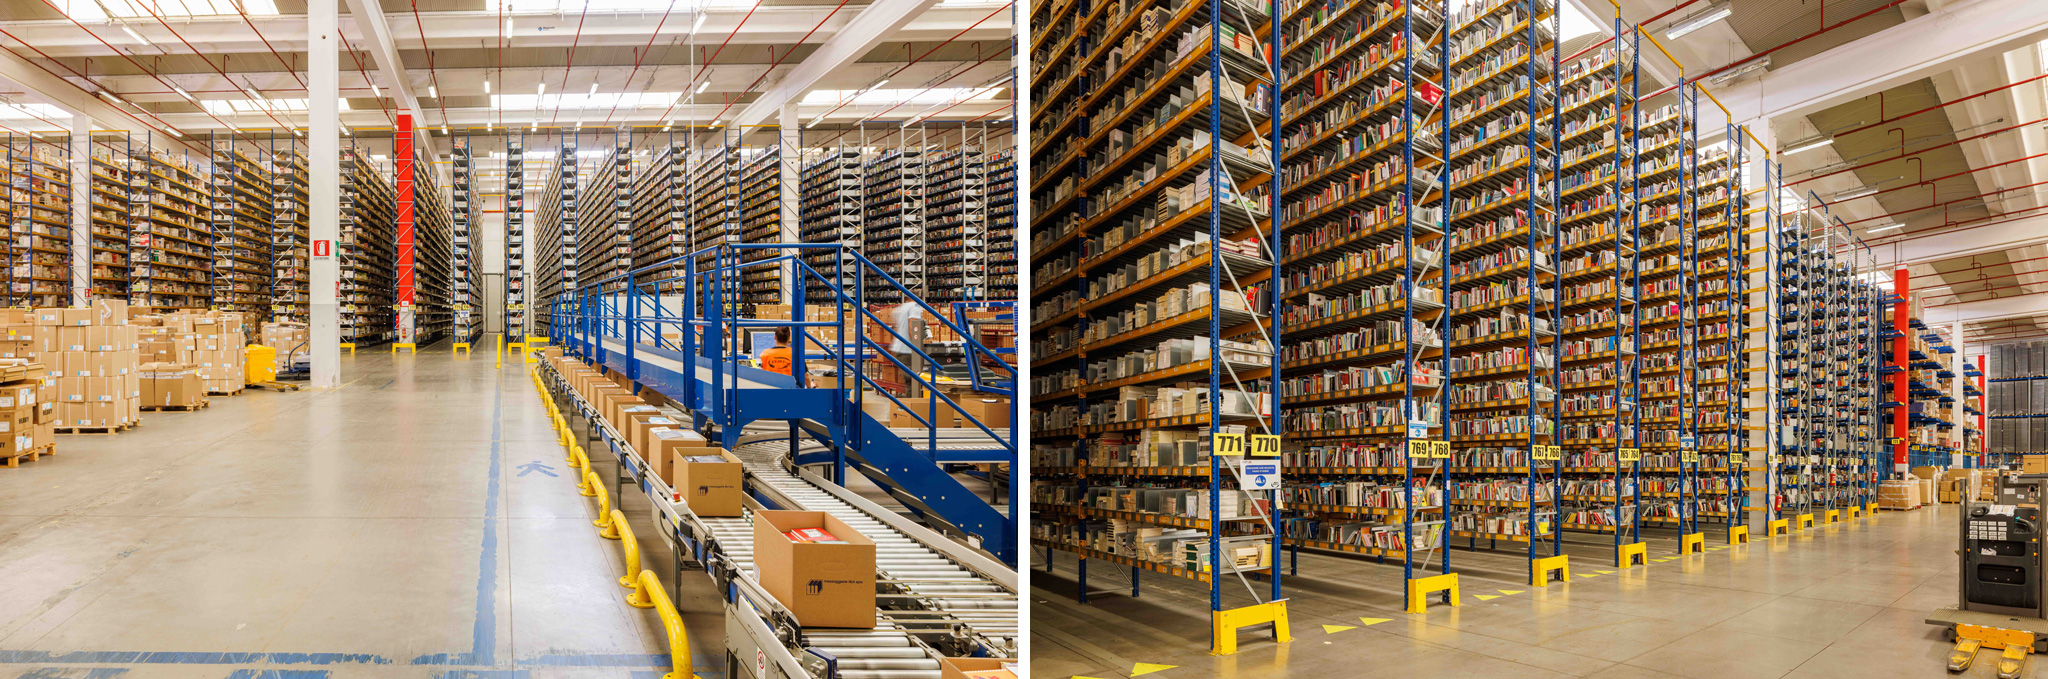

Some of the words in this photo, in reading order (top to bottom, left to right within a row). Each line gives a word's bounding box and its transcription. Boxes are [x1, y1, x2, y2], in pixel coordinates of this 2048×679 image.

[1218, 436, 1242, 452] 771
[1256, 437, 1278, 453] 770
[1412, 442, 1427, 455] 769
[1434, 443, 1449, 456] 768
[1534, 446, 1545, 458] 767
[1549, 447, 1560, 458] 766
[1620, 450, 1629, 459] 765
[1630, 450, 1639, 459] 764
